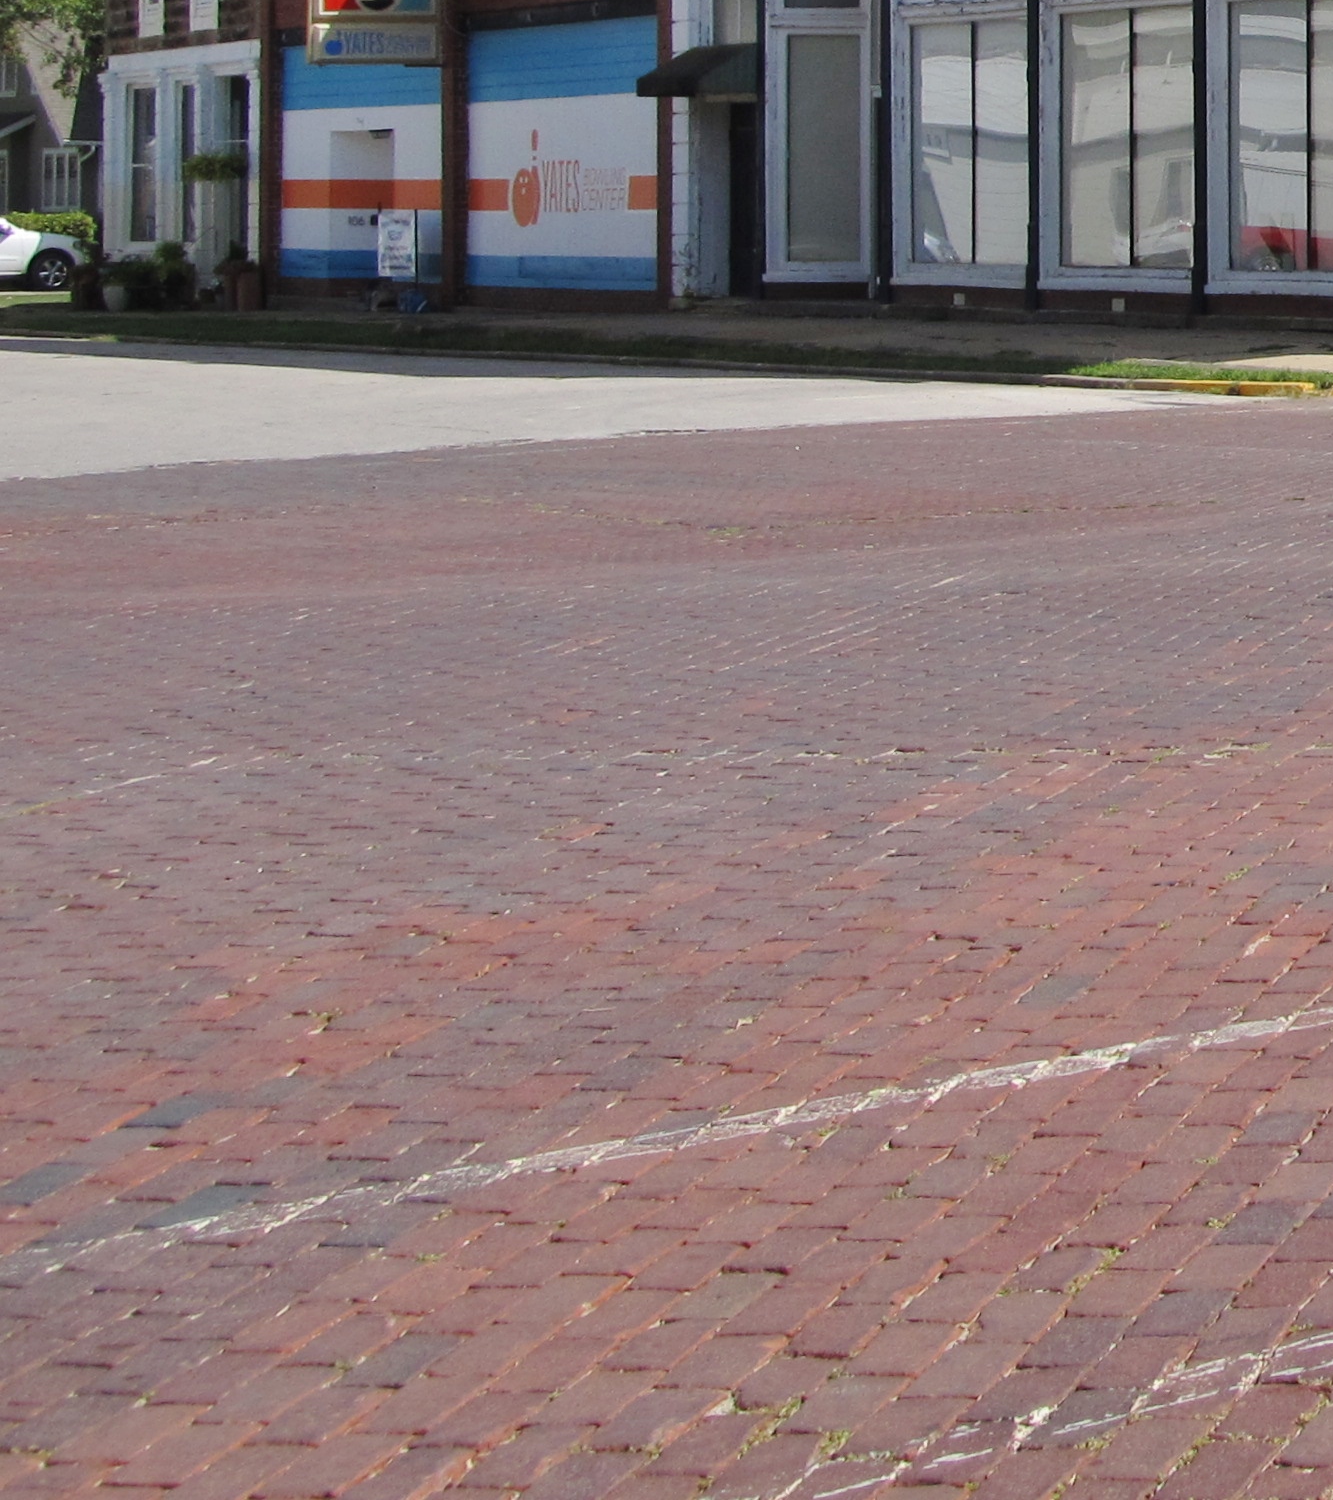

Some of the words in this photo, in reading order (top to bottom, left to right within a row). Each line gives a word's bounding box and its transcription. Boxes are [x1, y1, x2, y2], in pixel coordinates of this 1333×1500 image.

[343, 30, 385, 54] YATES
[541, 159, 581, 213] YATES
[581, 187, 626, 211] CENTER
